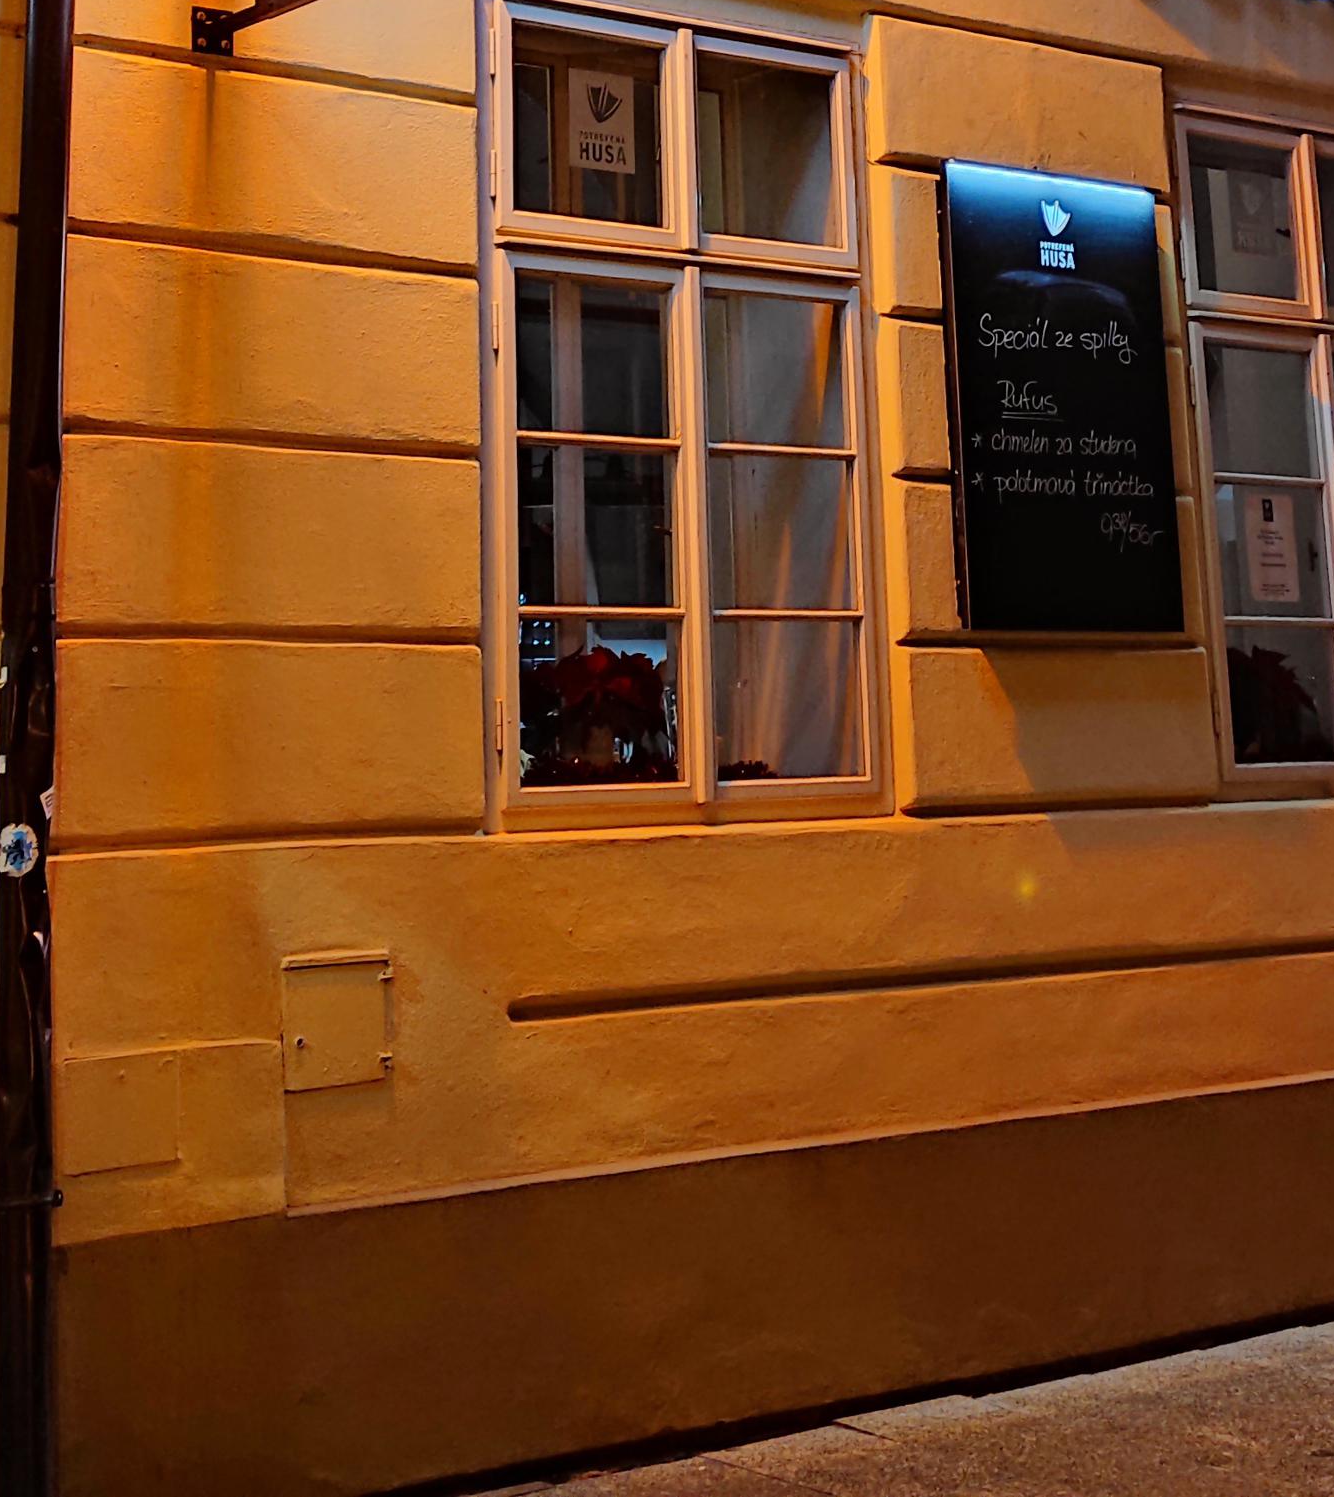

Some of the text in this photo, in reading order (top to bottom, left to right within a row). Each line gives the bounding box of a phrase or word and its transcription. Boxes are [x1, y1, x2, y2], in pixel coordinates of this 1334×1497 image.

[579, 142, 627, 165] HUSA
[1040, 249, 1076, 270] HUSA
[978, 312, 1138, 364] Speciál ze spilky
[997, 379, 1058, 415] Rufus
[991, 428, 1137, 460] chmelen za studena
